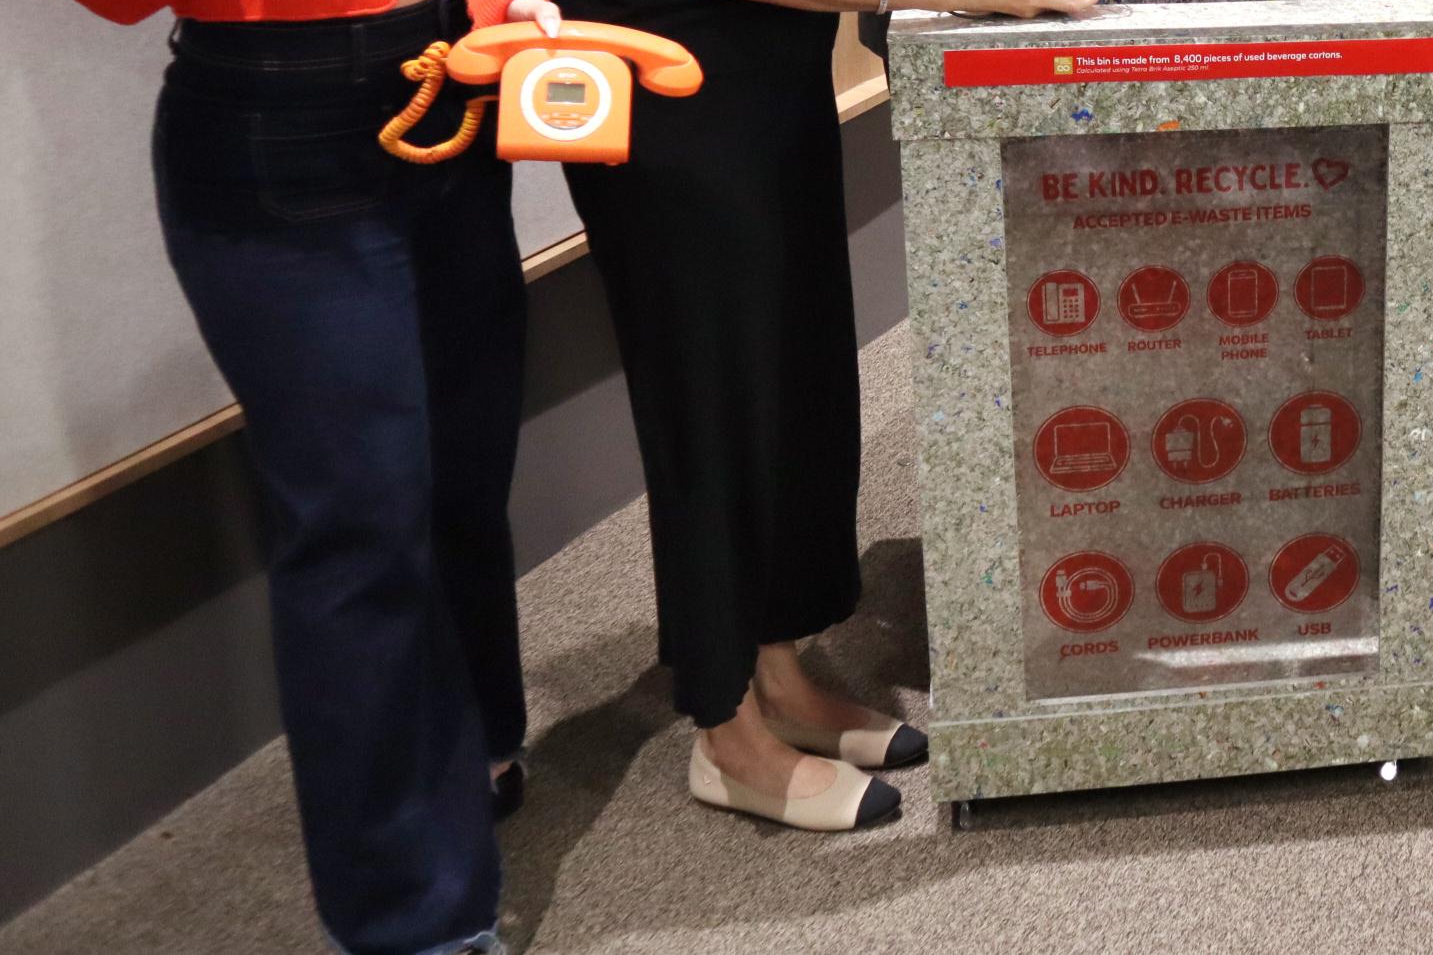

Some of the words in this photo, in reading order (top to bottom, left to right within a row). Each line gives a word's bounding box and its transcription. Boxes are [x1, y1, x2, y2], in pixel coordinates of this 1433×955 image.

[1076, 57, 1095, 66] This
[1097, 56, 1110, 65] bin
[1112, 56, 1120, 65] is
[1122, 55, 1147, 65] made
[1149, 55, 1170, 64] from
[1203, 53, 1231, 64] pieces
[1233, 52, 1243, 62] of
[1244, 52, 1265, 61] used
[1267, 51, 1307, 61] beverage
[1308, 51, 1343, 59] cartons.
[1042, 173, 1079, 200] BE
[1088, 169, 1166, 198] KIND.
[1175, 163, 1309, 194] RECYCLE.
[1073, 211, 1168, 229] ACCEPTED
[1171, 206, 1252, 225] E-WASTE
[1256, 204, 1312, 220] ITEMS
[1218, 332, 1270, 346] MOBILE
[1305, 327, 1353, 340] TABLET
[1027, 341, 1107, 357] TELEPHONE
[1127, 339, 1182, 352] ROUTER
[1221, 347, 1268, 360] PHONE
[1268, 482, 1361, 501] BATTERIES
[1050, 500, 1121, 518] LAPTOP
[1159, 492, 1242, 510] CHARGER
[1298, 622, 1332, 636] USB
[1148, 628, 1259, 650] POWERBANK
[1059, 641, 1119, 658] CORDS
